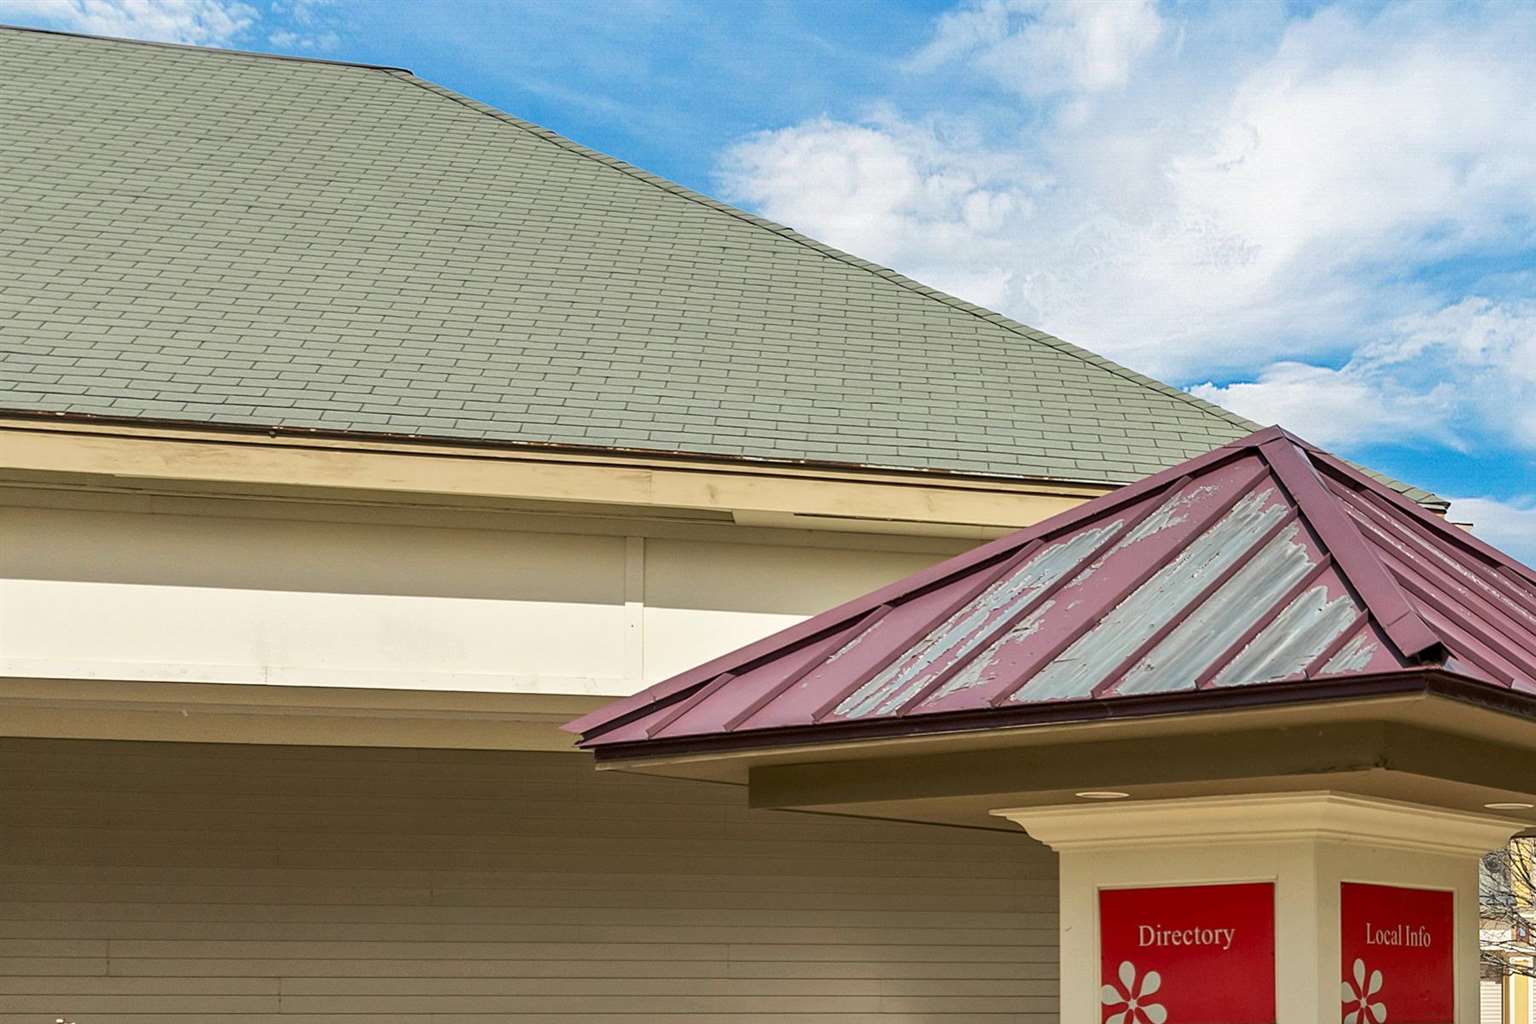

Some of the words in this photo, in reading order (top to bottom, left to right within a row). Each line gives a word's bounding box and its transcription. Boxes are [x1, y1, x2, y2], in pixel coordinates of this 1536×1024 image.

[1137, 924, 1235, 951] Directory
[1366, 922, 1402, 947] Local
[1405, 924, 1432, 949] Info
